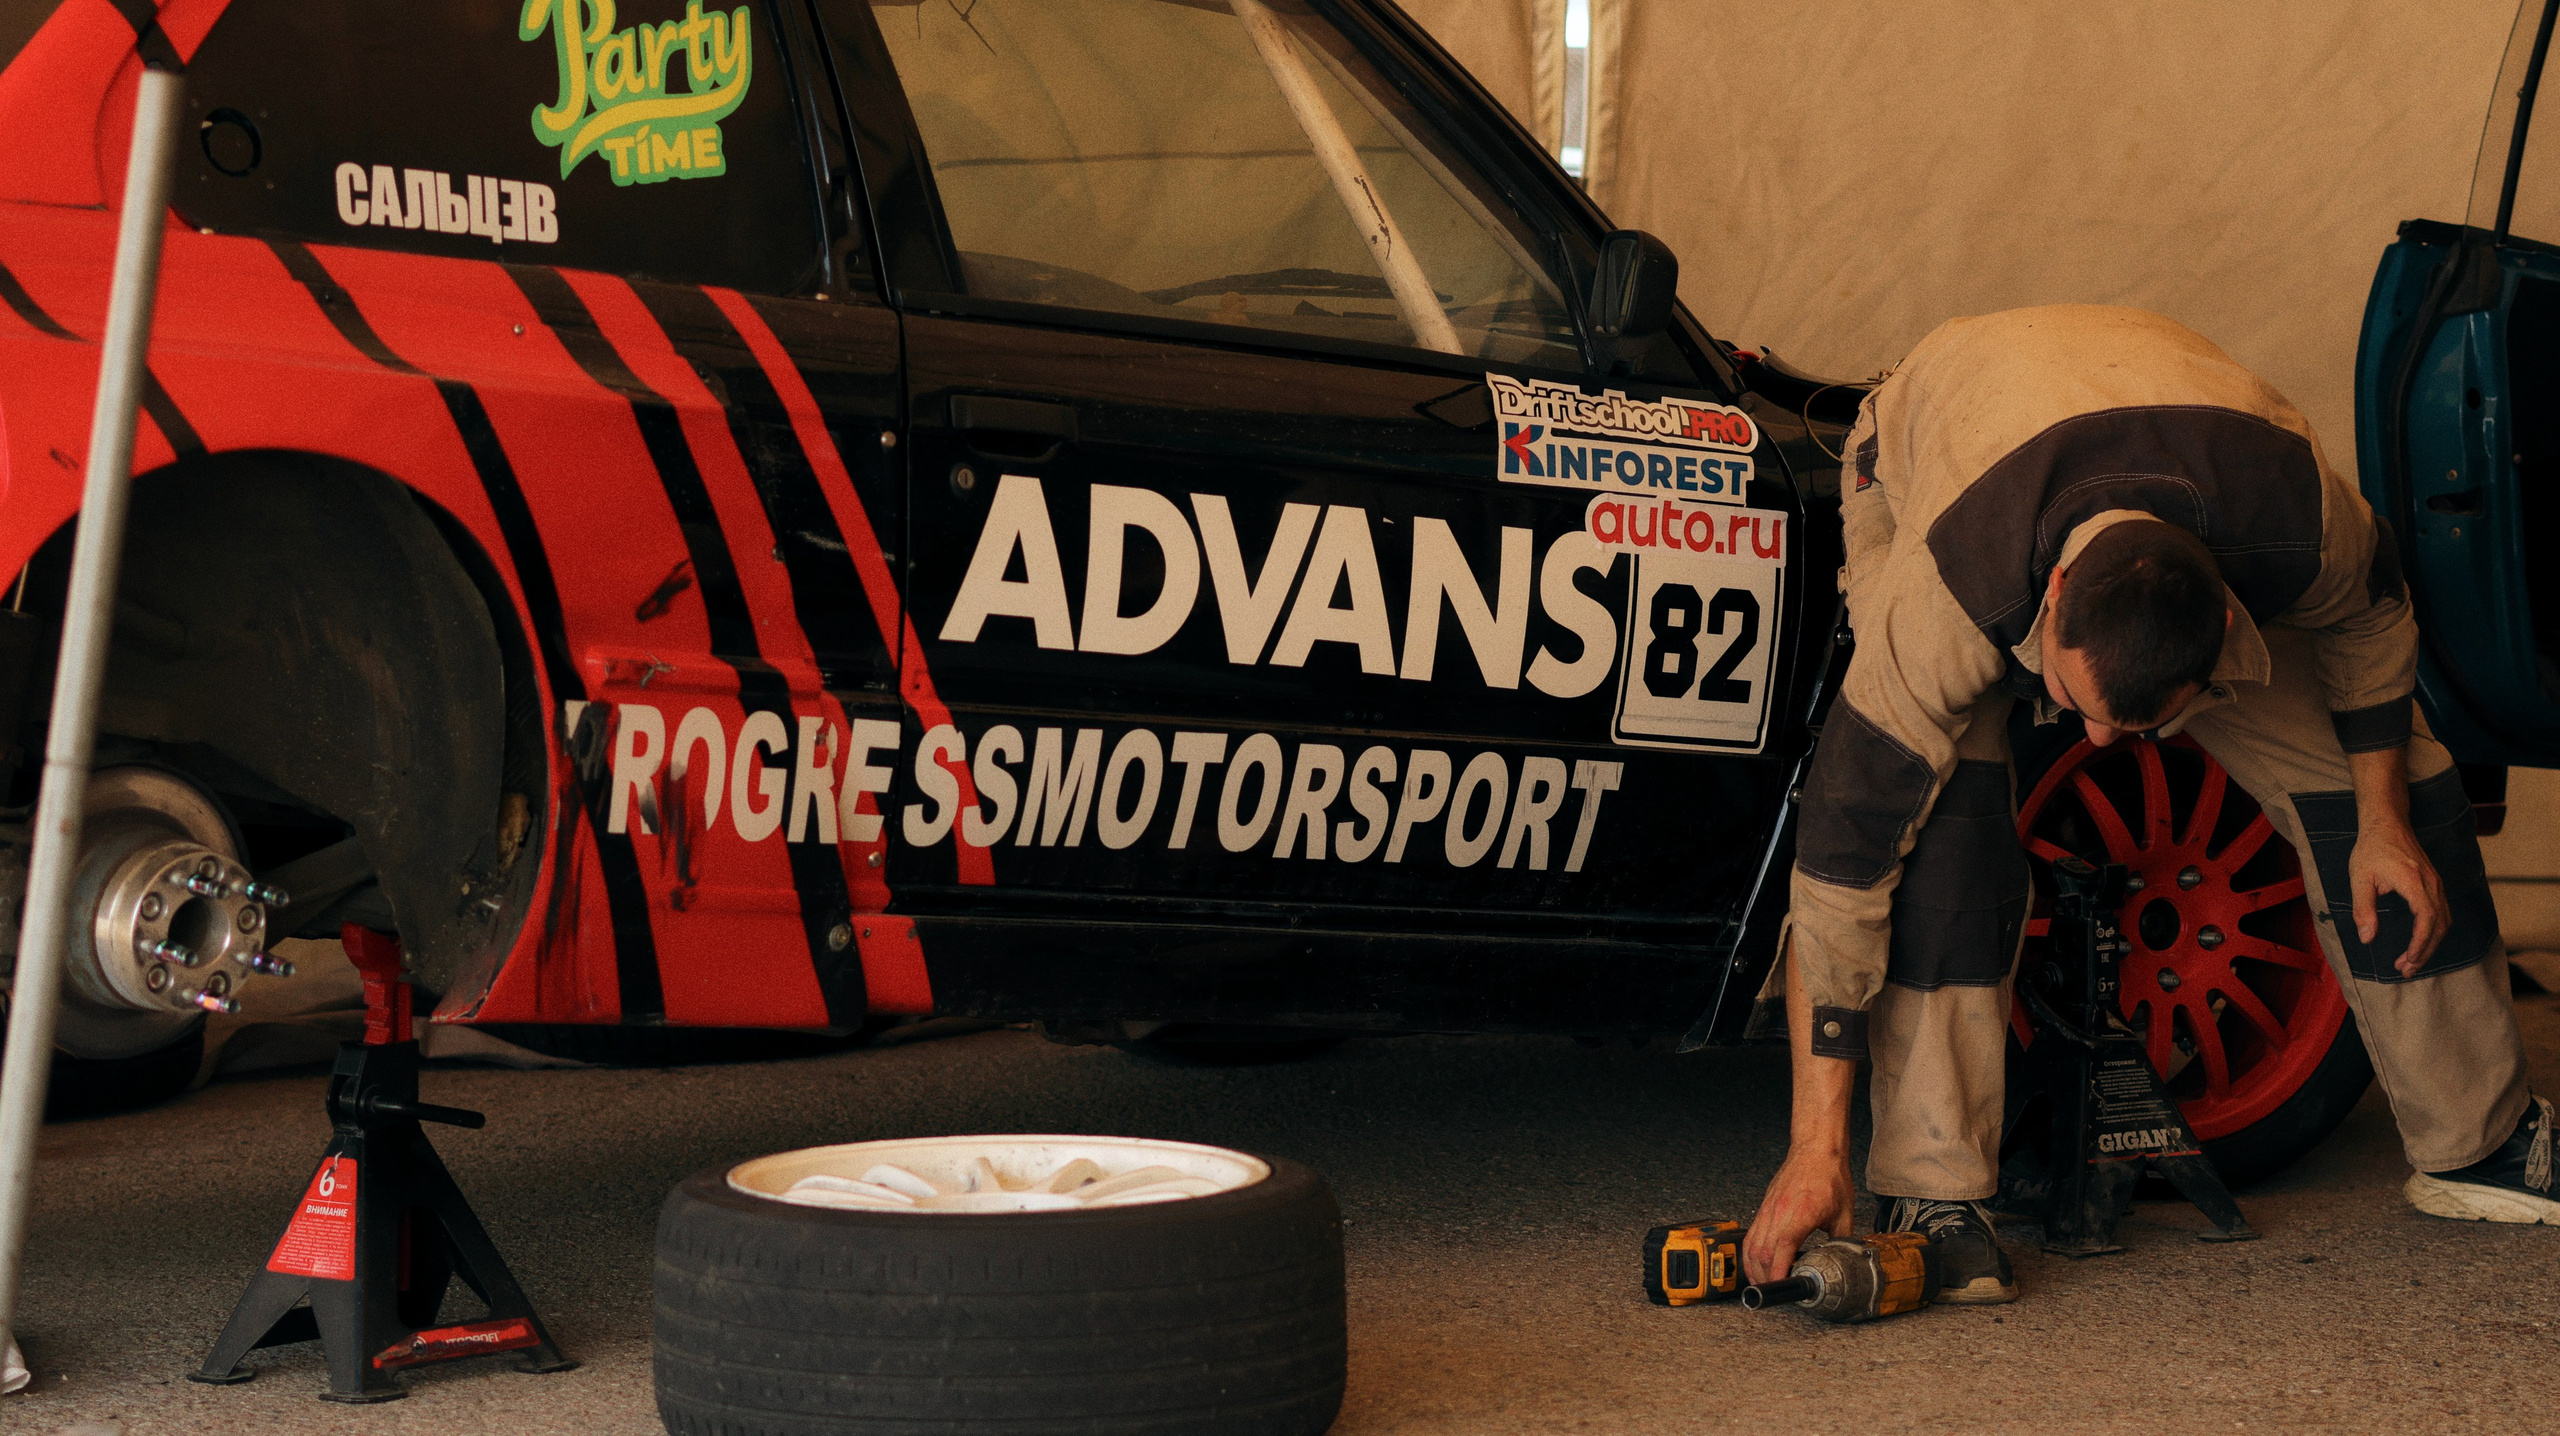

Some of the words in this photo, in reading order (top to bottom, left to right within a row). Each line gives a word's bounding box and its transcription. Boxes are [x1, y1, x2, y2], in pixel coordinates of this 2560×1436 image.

[520, 0, 752, 152] Party
[1503, 421, 1748, 496] KINFOREST
[1591, 500, 1782, 560] auto.ru
[938, 473, 1628, 699] ADVANS
[1642, 582, 1761, 704] 82
[305, 1204, 349, 1218] ВНИМАНИЕ
